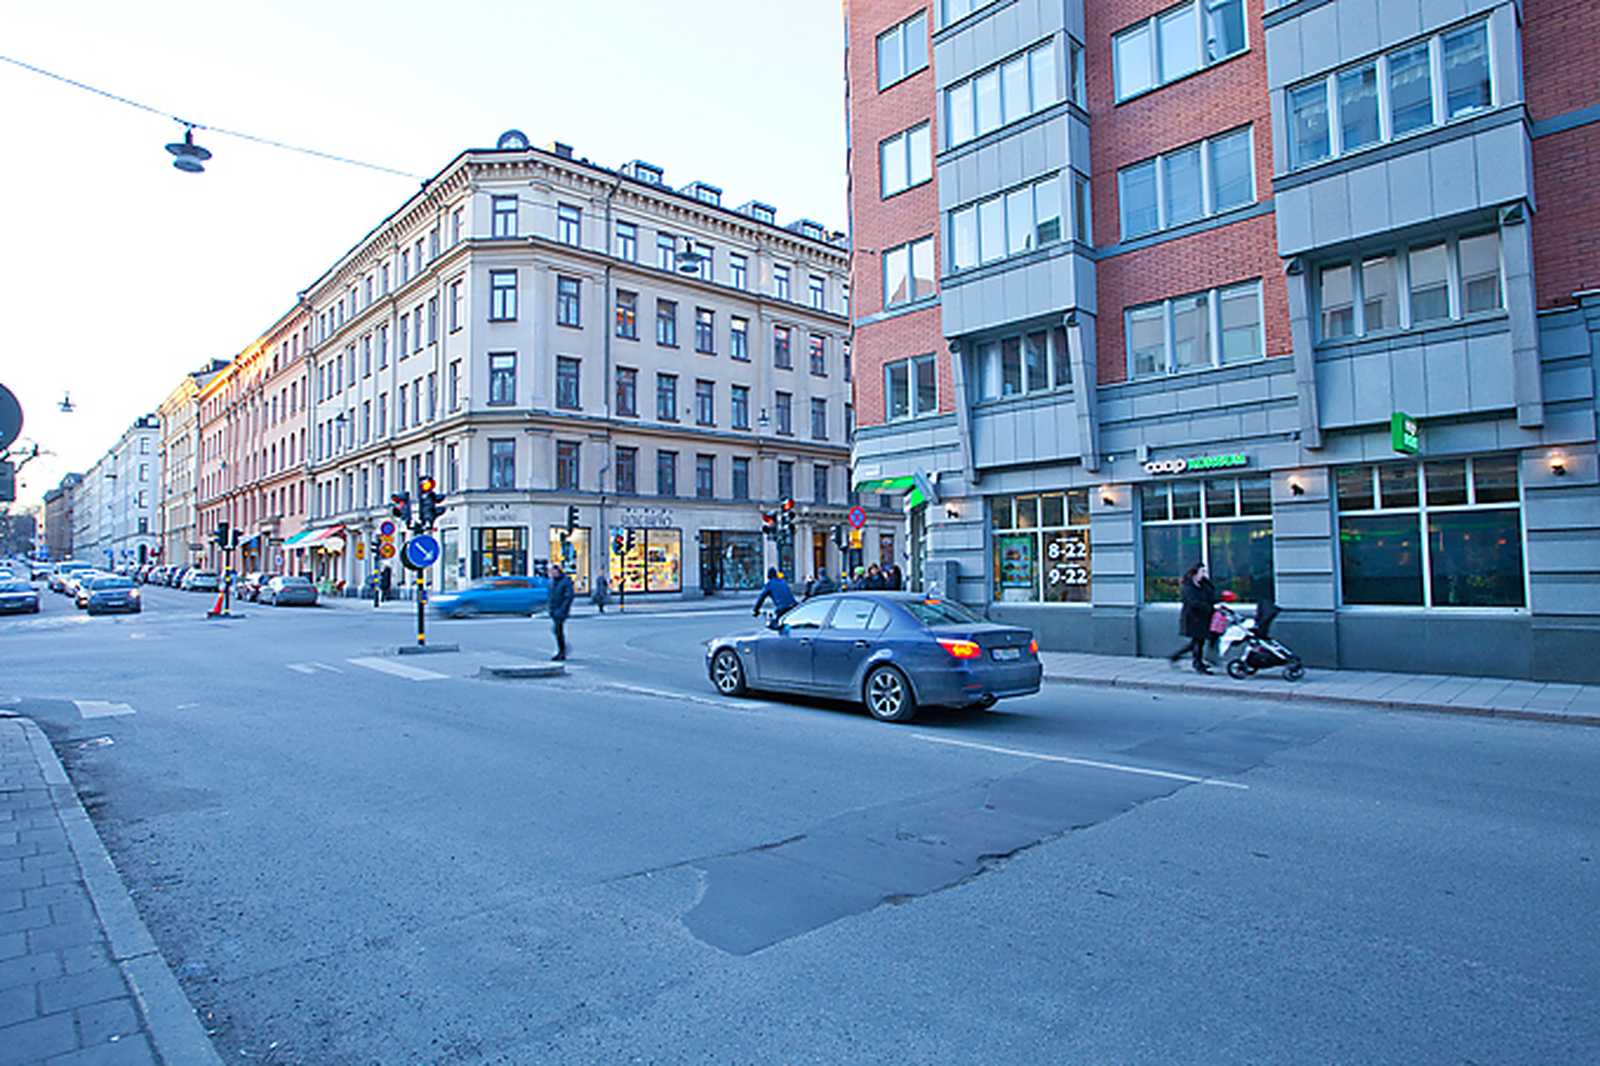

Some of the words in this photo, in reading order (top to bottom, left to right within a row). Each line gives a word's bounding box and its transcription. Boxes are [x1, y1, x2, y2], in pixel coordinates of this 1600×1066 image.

[1145, 459, 1186, 473] coop
[1187, 453, 1247, 470] KONSUM
[1048, 543, 1087, 558] 8-22
[1048, 569, 1088, 585] 9-22
